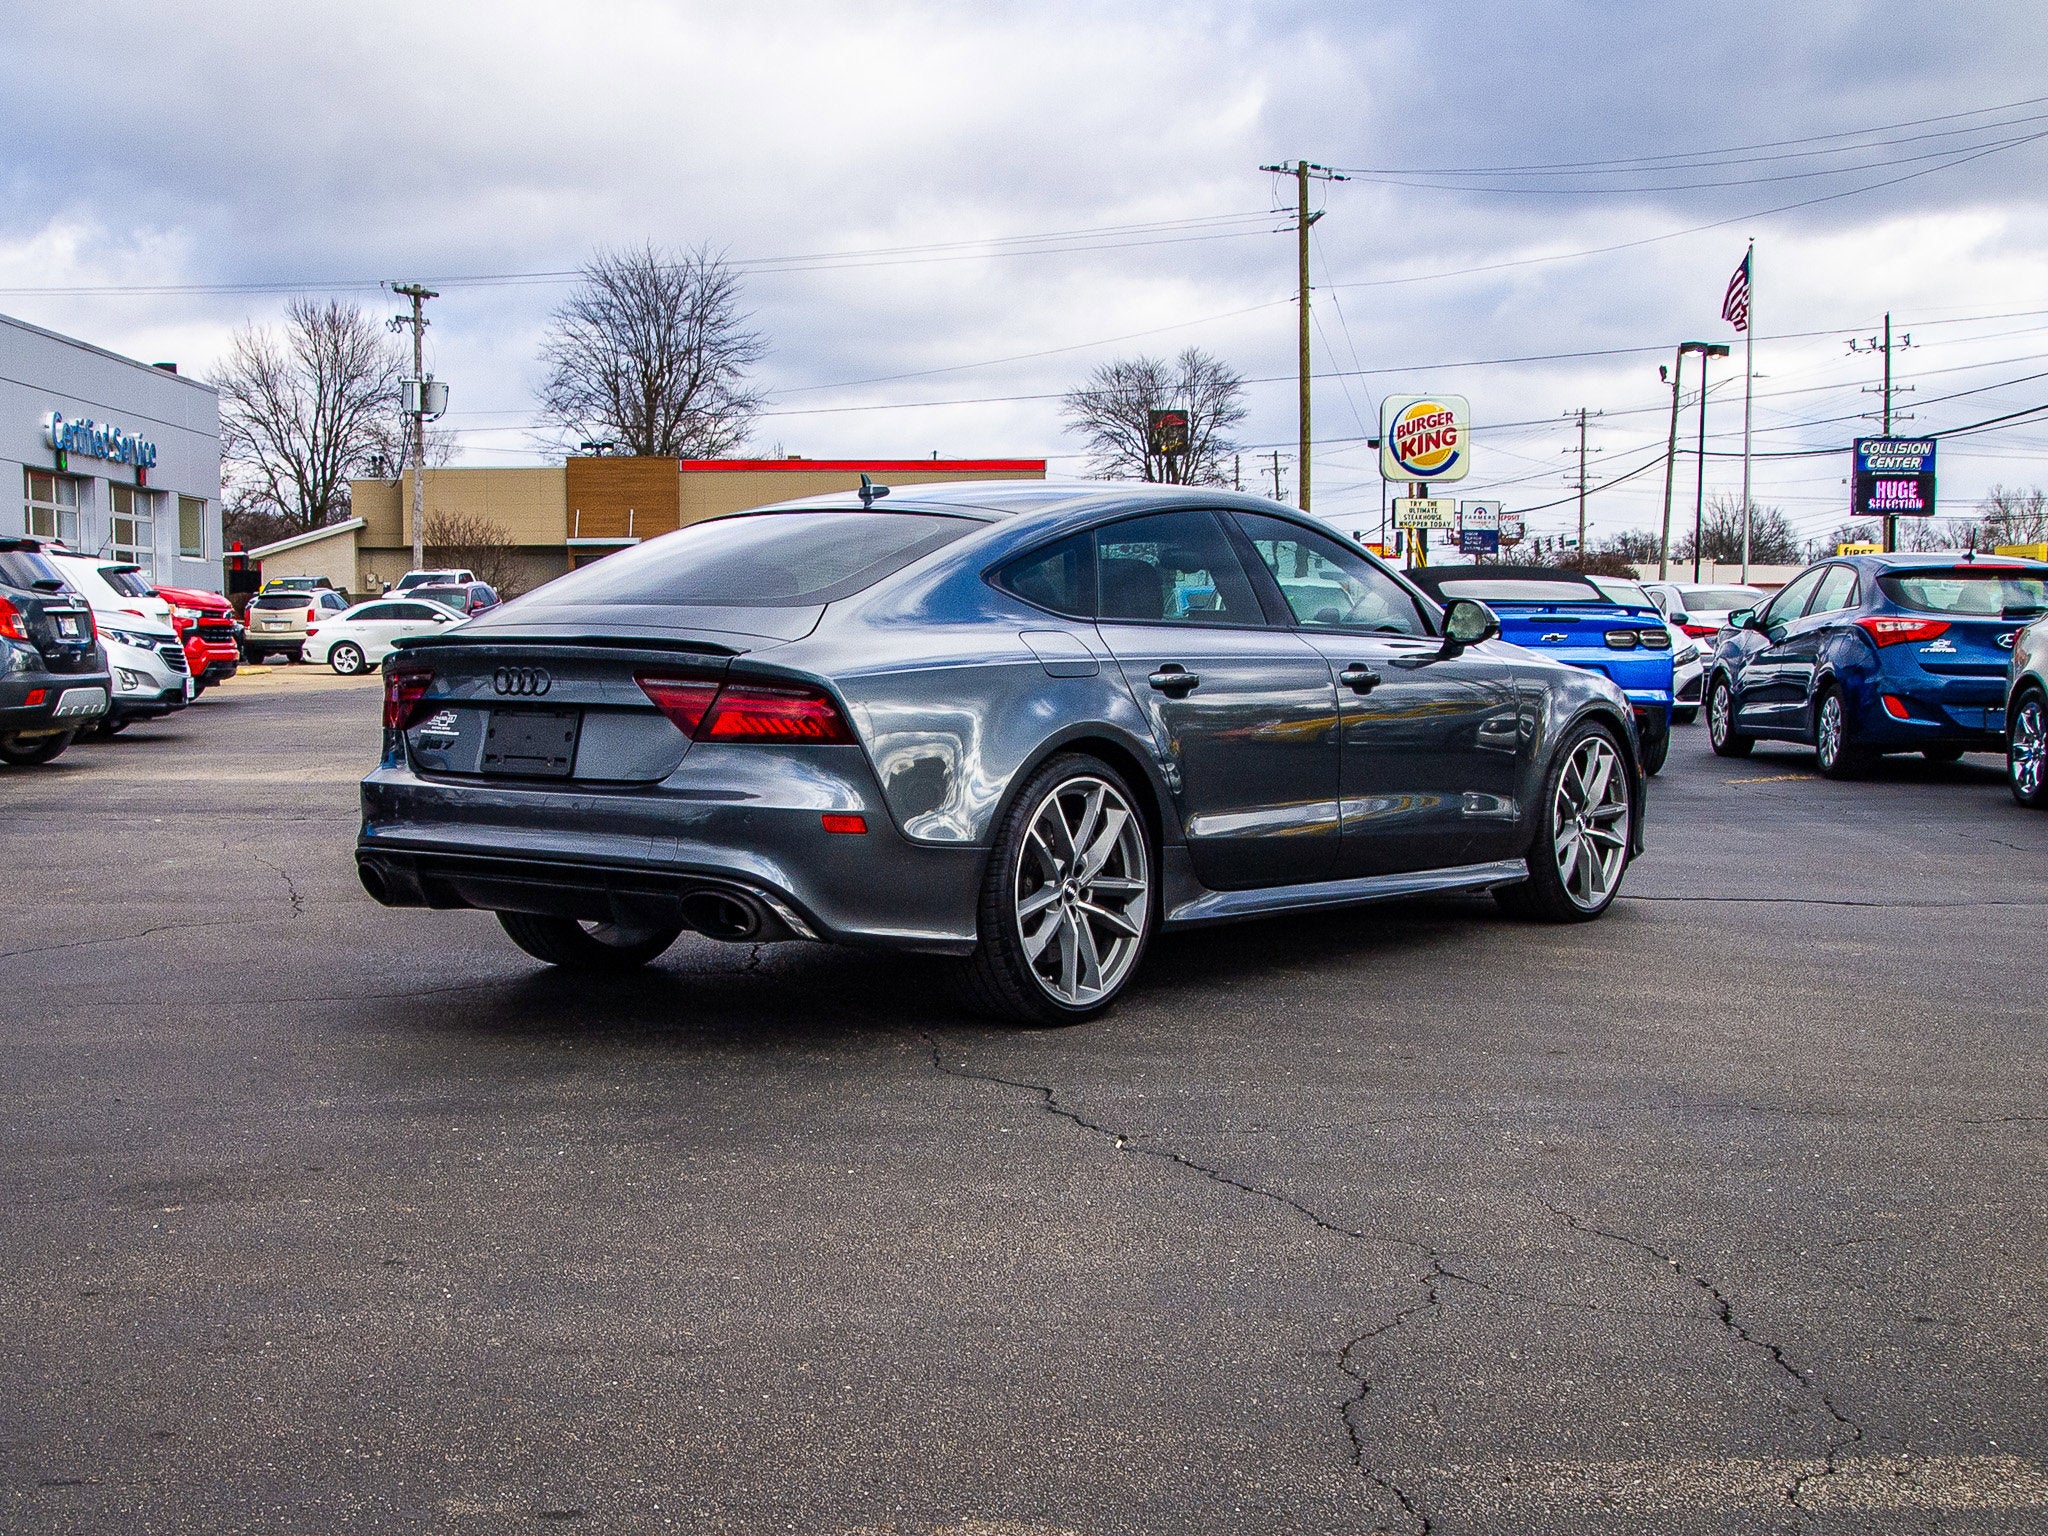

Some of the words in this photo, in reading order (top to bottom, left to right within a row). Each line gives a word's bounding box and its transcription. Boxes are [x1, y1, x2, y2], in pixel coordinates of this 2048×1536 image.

[1396, 411, 1454, 440] BURGER
[46, 411, 109, 459] Certified
[111, 427, 157, 468] Service
[1400, 427, 1457, 461] KING
[1860, 441, 1932, 455] COLLISION
[1866, 454, 1922, 470] CENTER
[1876, 480, 1918, 498] HUGE
[1867, 498, 1924, 509] SELECTION
